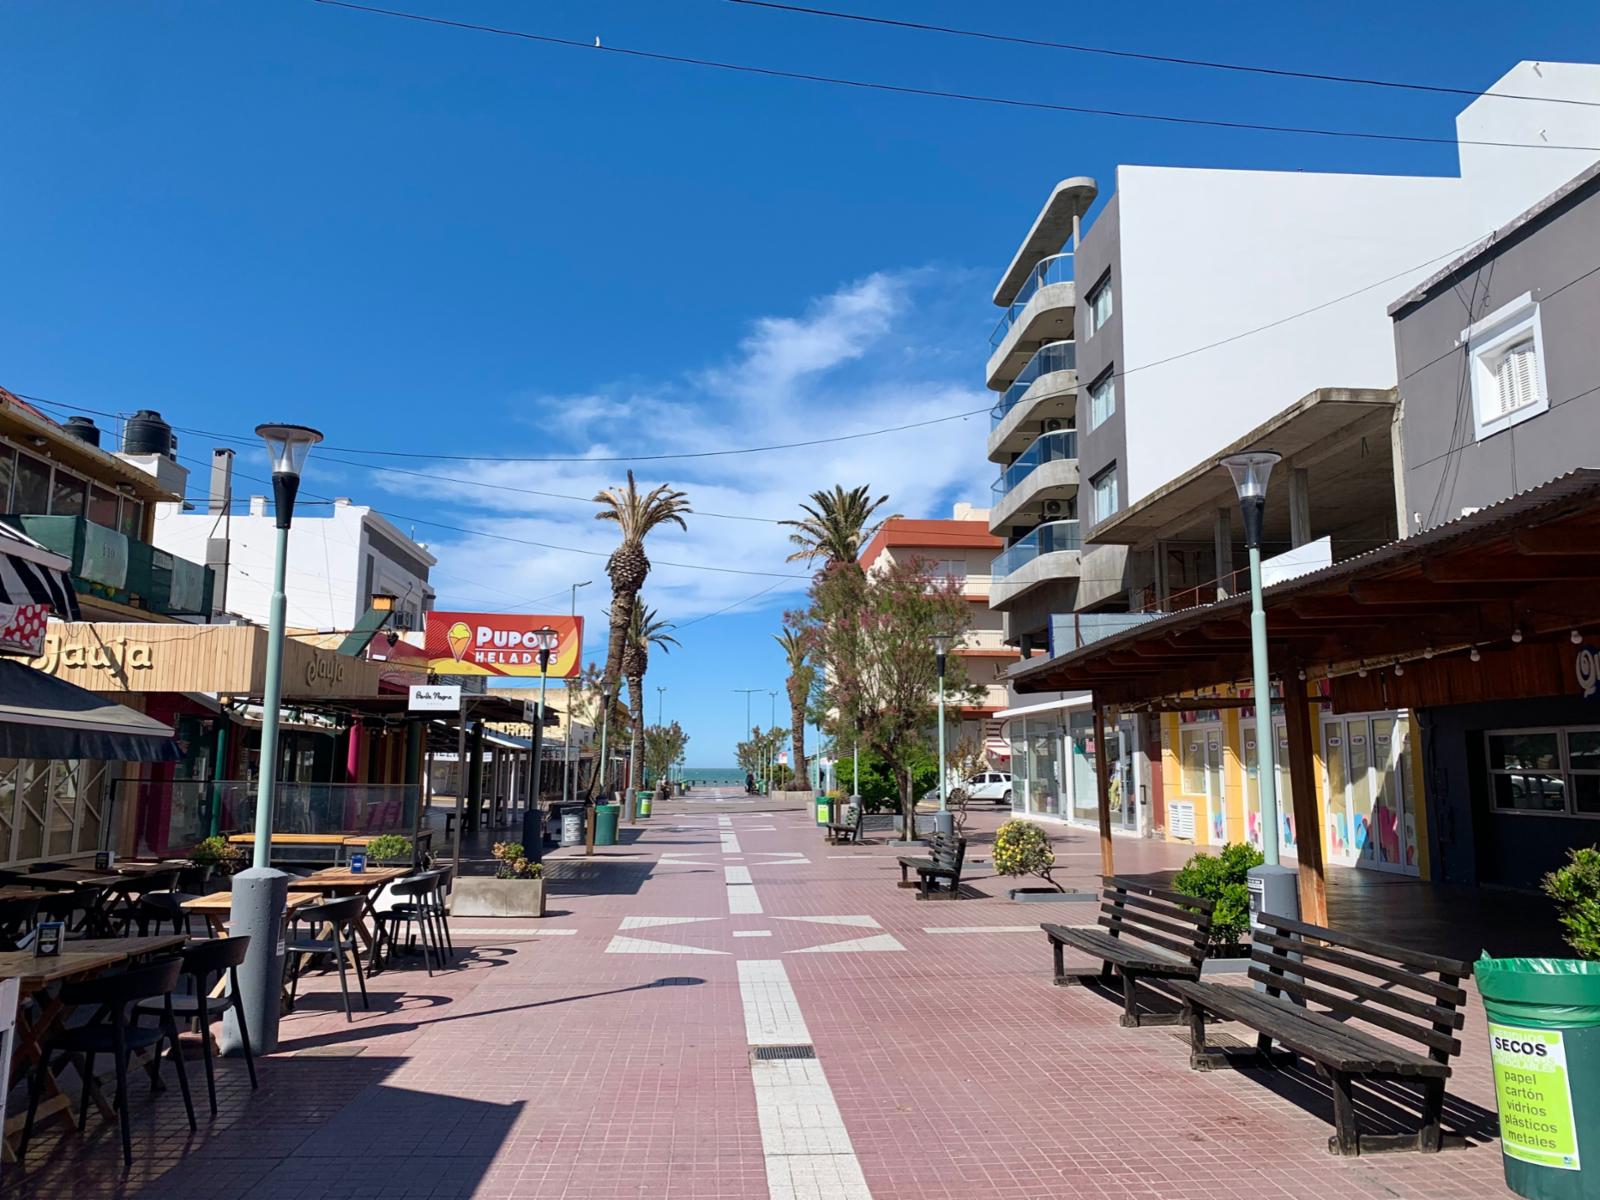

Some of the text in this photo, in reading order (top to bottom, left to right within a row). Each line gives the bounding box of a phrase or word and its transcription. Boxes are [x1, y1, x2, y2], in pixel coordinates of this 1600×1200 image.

[20, 634, 152, 677] Jauja
[305, 650, 344, 687] Jauja
[1495, 1037, 1548, 1057] SECOS
[1504, 1071, 1537, 1086] papel
[1505, 1086, 1545, 1101] cartón
[1507, 1100, 1548, 1117] vidrios
[1504, 1114, 1558, 1134] plásticos
[1508, 1131, 1557, 1149] metales
